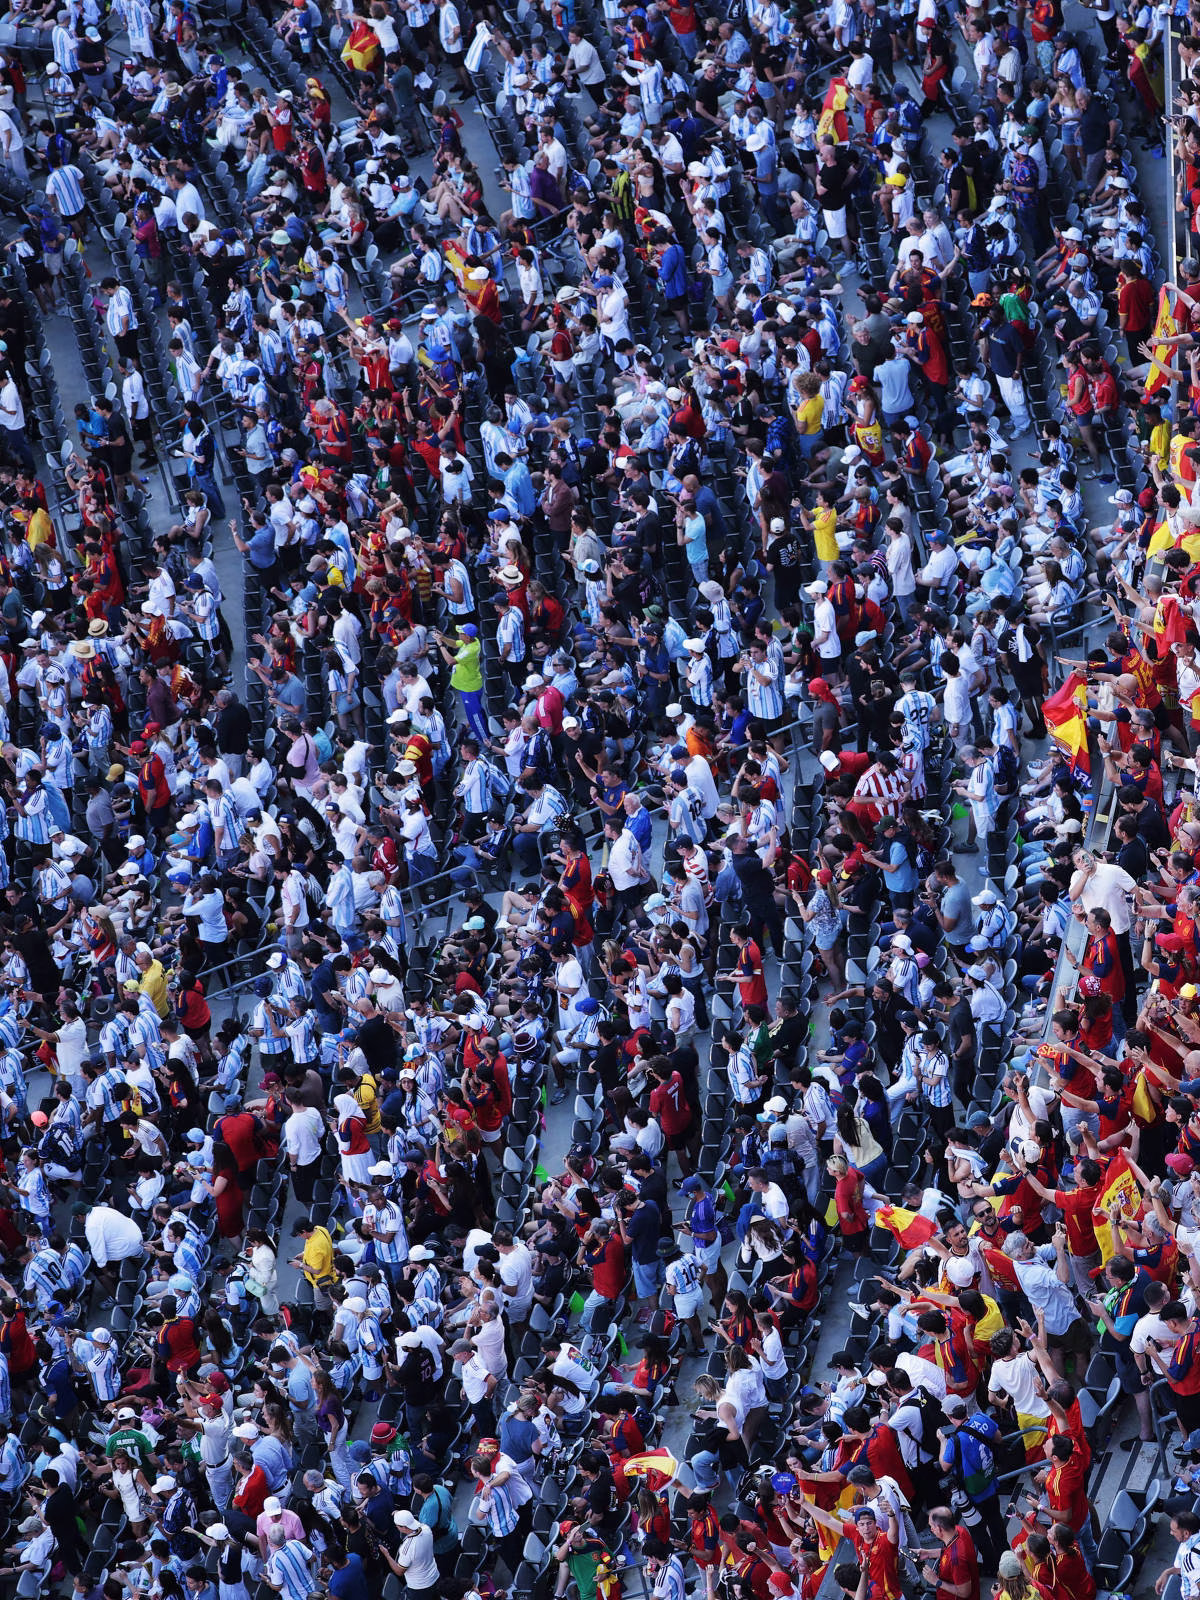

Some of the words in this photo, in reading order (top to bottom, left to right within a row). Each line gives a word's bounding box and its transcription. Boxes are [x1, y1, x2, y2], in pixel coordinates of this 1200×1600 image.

[910, 707, 929, 724] 22
[672, 1092, 679, 1111] 7
[42, 1262, 62, 1285] 10
[421, 1367, 432, 1382] 10
